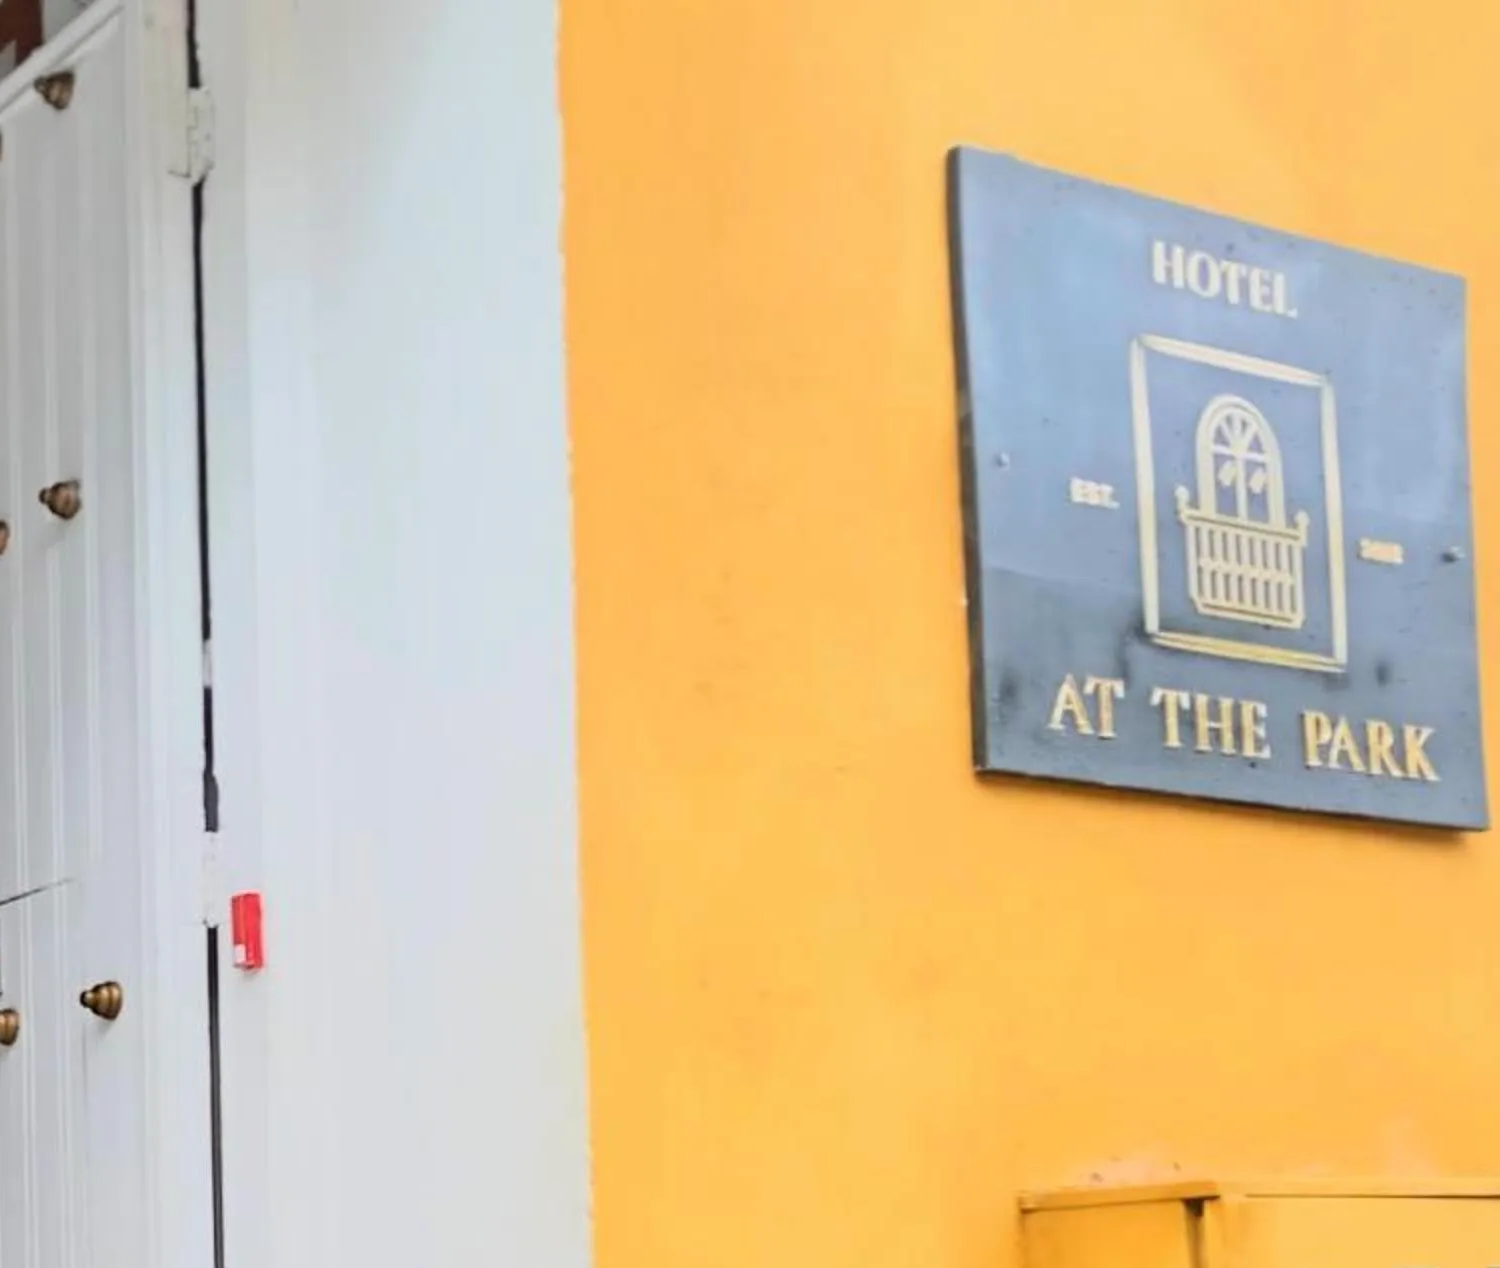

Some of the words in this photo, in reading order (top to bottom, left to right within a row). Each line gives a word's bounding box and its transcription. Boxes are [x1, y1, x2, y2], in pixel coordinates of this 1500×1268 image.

[1152, 239, 1298, 319] HOTEL
[1047, 672, 1126, 738] AT
[1150, 686, 1272, 759] THE
[1303, 708, 1441, 782] PARK
